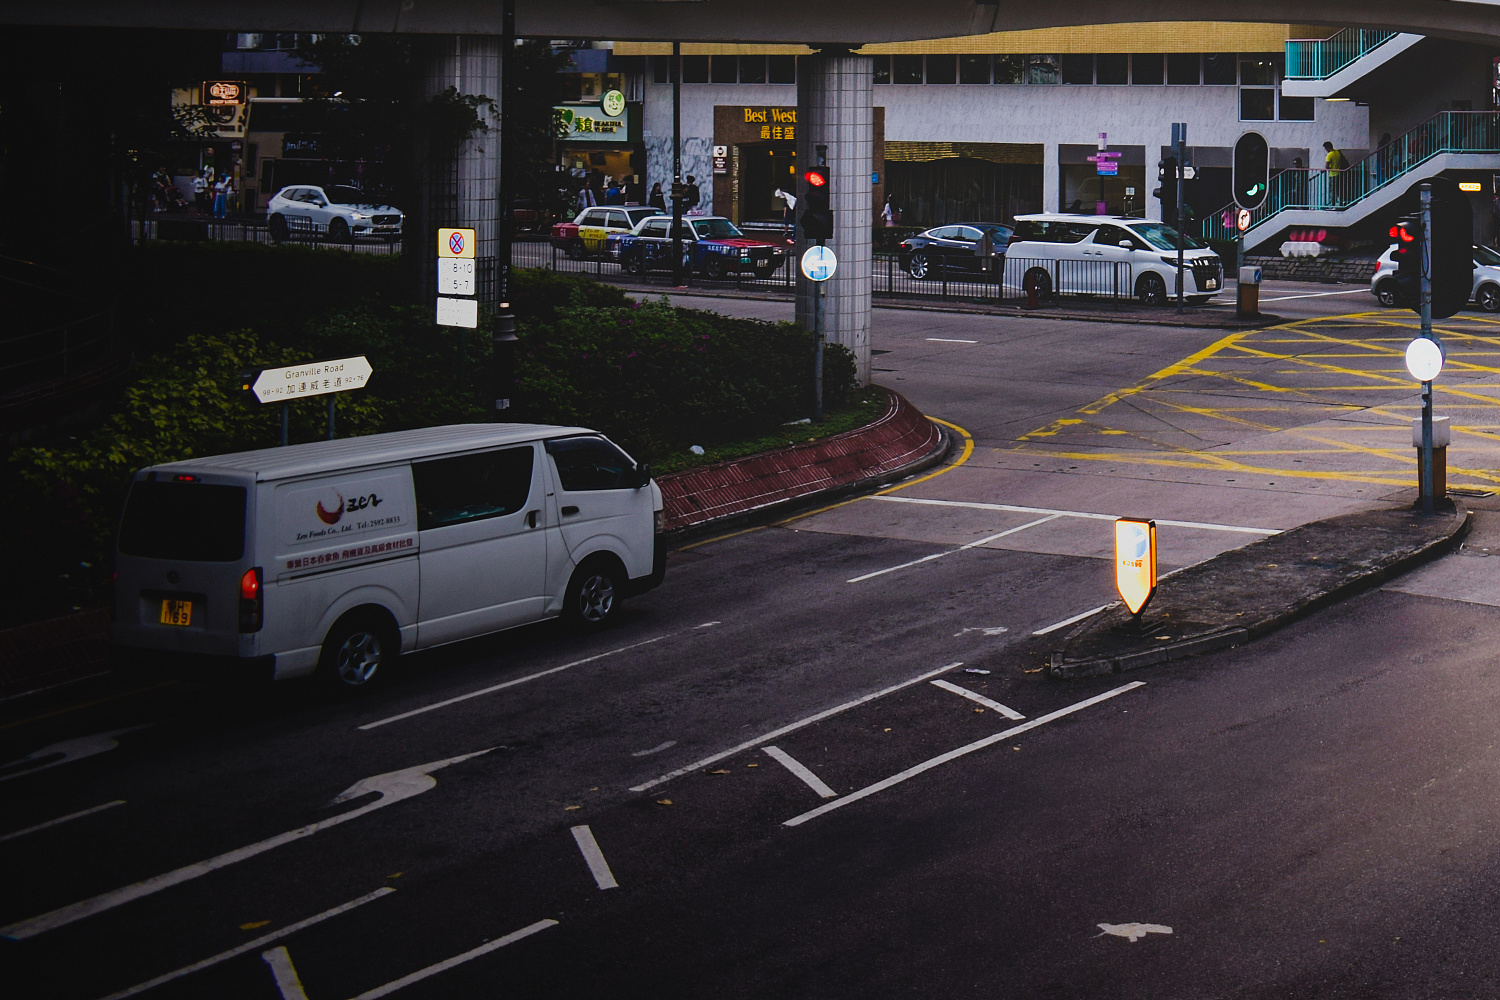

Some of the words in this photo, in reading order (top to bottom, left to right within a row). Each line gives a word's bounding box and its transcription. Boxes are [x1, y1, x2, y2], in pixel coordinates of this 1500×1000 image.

[744, 108, 767, 123] Best
[575, 117, 594, 133] 素食
[760, 125, 795, 140] 最佳盛
[452, 262, 473, 274] 8-10
[453, 279, 469, 290] 5-7
[285, 367, 322, 380] Granville
[324, 364, 344, 374] Road
[286, 377, 342, 395] 加連威老道
[296, 532, 308, 541] Zen
[309, 529, 326, 538] Foods
